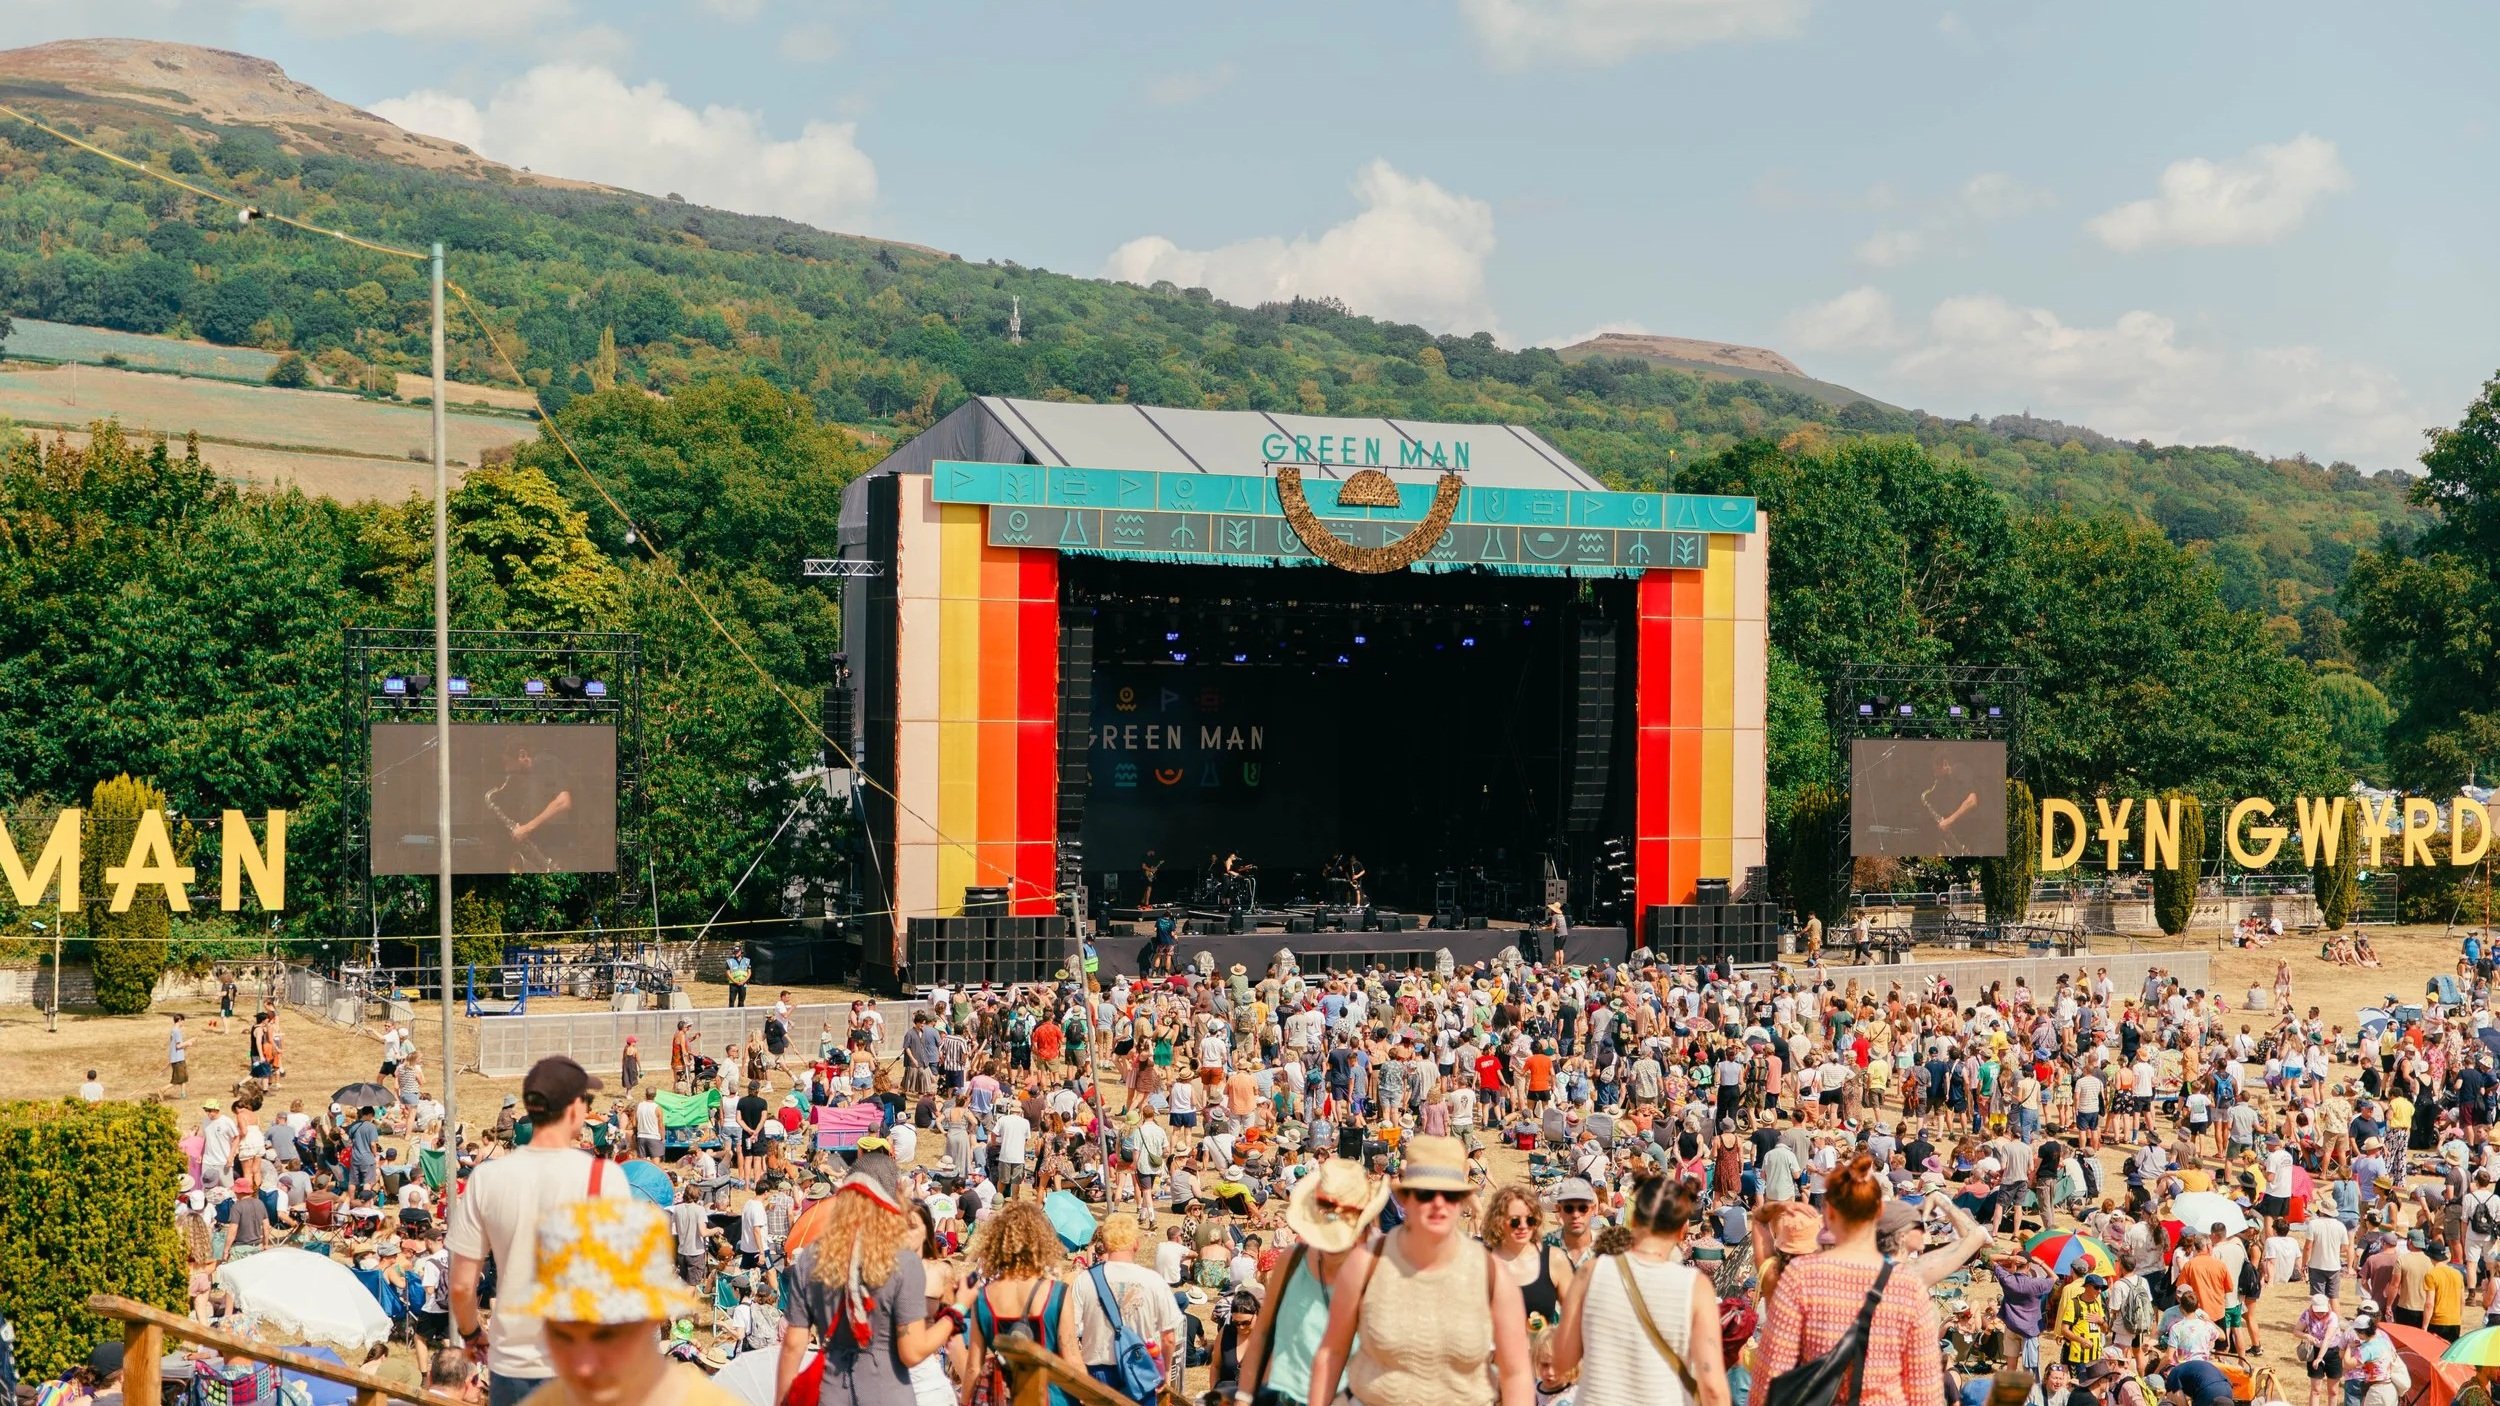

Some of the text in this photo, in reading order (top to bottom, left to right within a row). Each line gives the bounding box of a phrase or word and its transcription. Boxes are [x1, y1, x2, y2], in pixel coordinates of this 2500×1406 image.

[1261, 432, 1470, 468] GREEN MAN
[1201, 725, 1264, 750] MAN
[0, 808, 286, 912] MAN
[2041, 796, 2492, 871] DYN GWYRD
